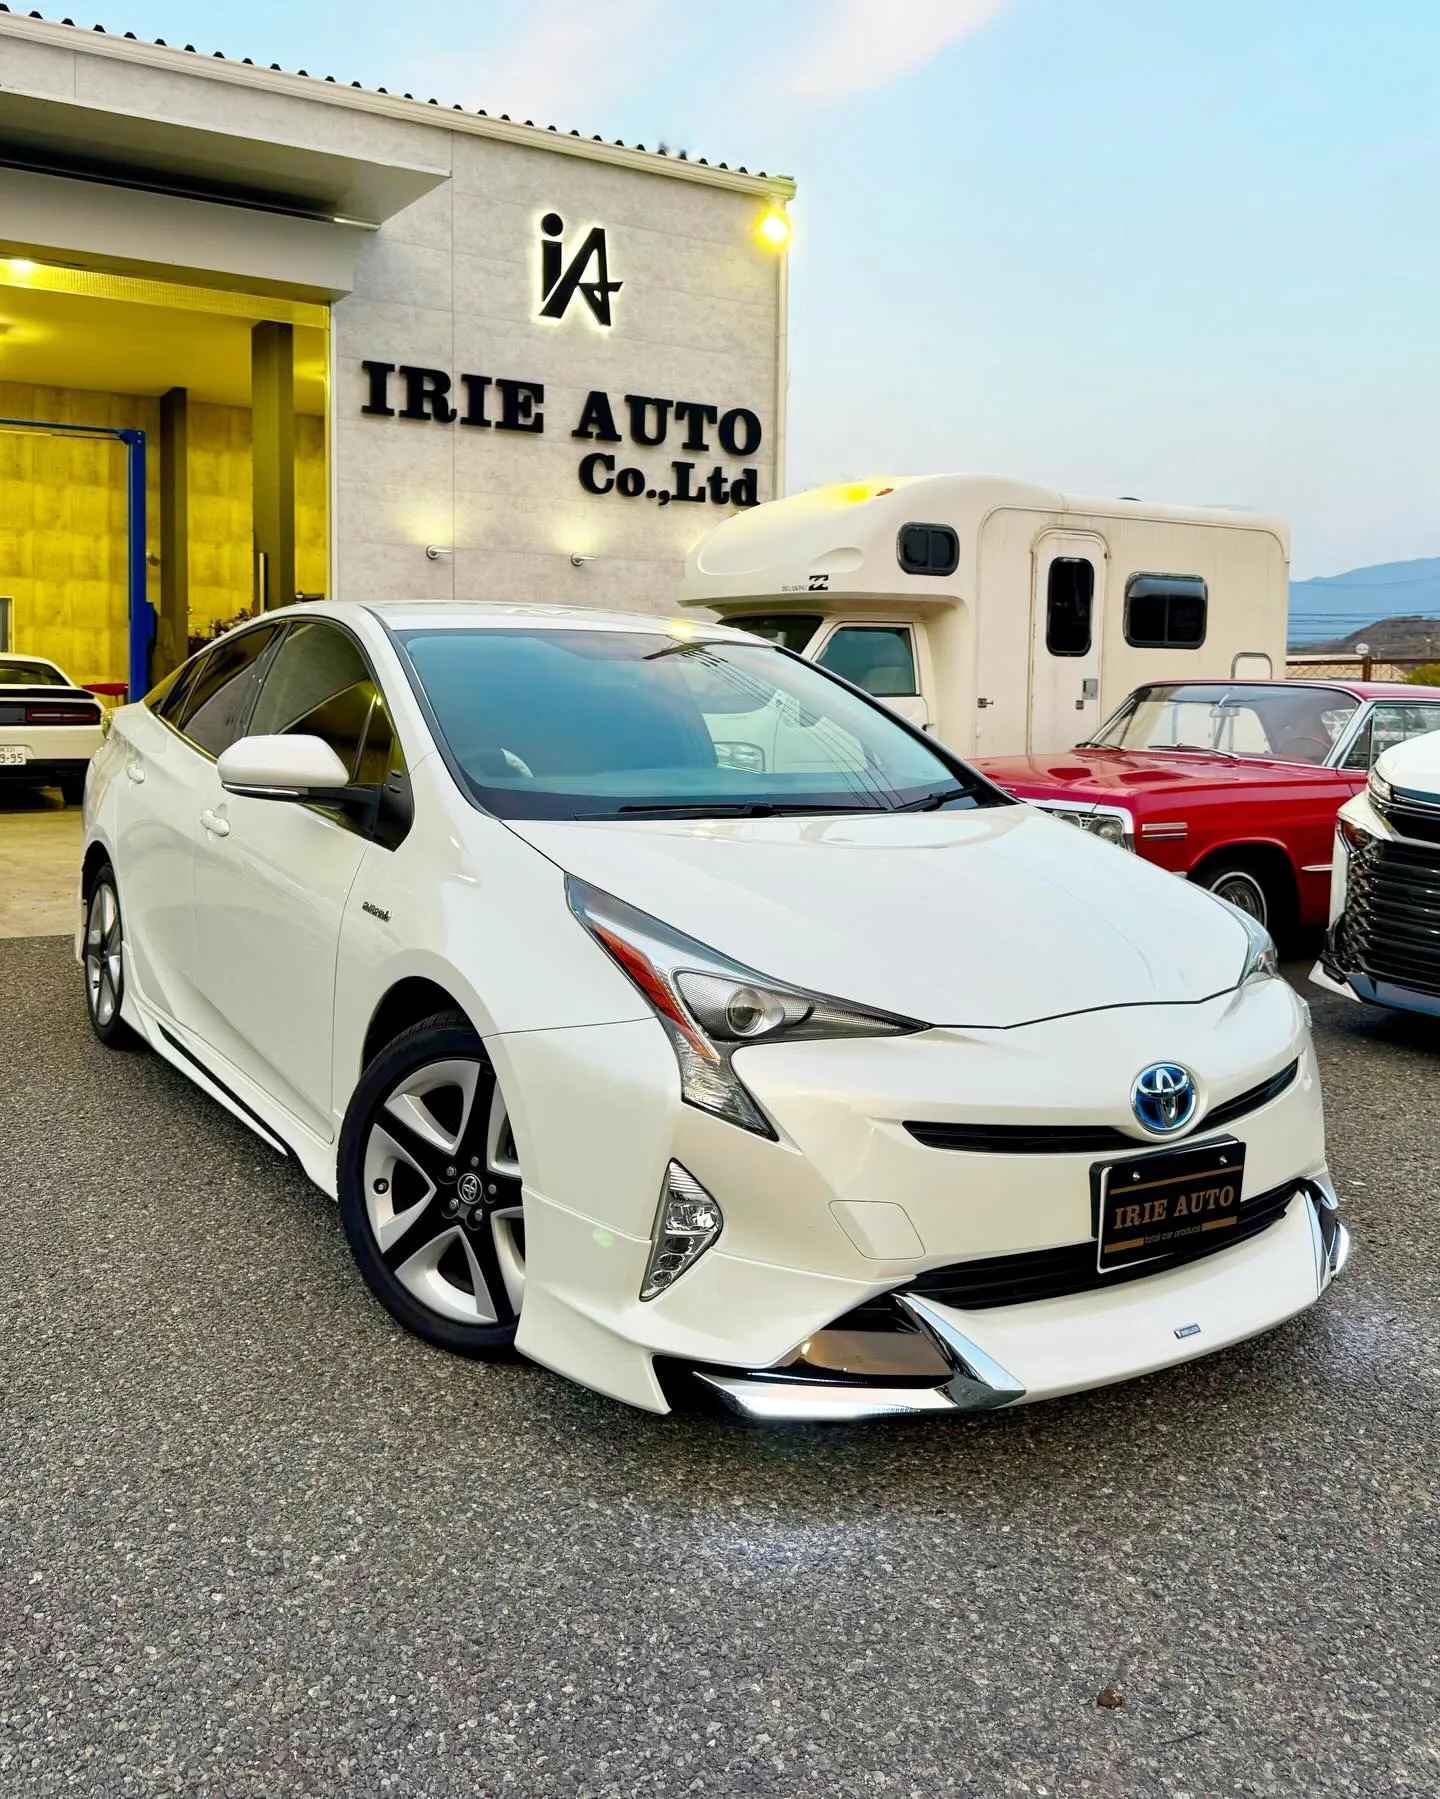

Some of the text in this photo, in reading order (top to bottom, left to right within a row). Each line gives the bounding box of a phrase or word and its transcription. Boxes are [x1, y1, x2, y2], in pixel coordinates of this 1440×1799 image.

[361, 360, 762, 456] IRIE AUTO
[578, 452, 760, 507] Co.,Ltd
[1113, 1185, 1235, 1230] IRIE AUTO
[1162, 1231, 1173, 1240] car
